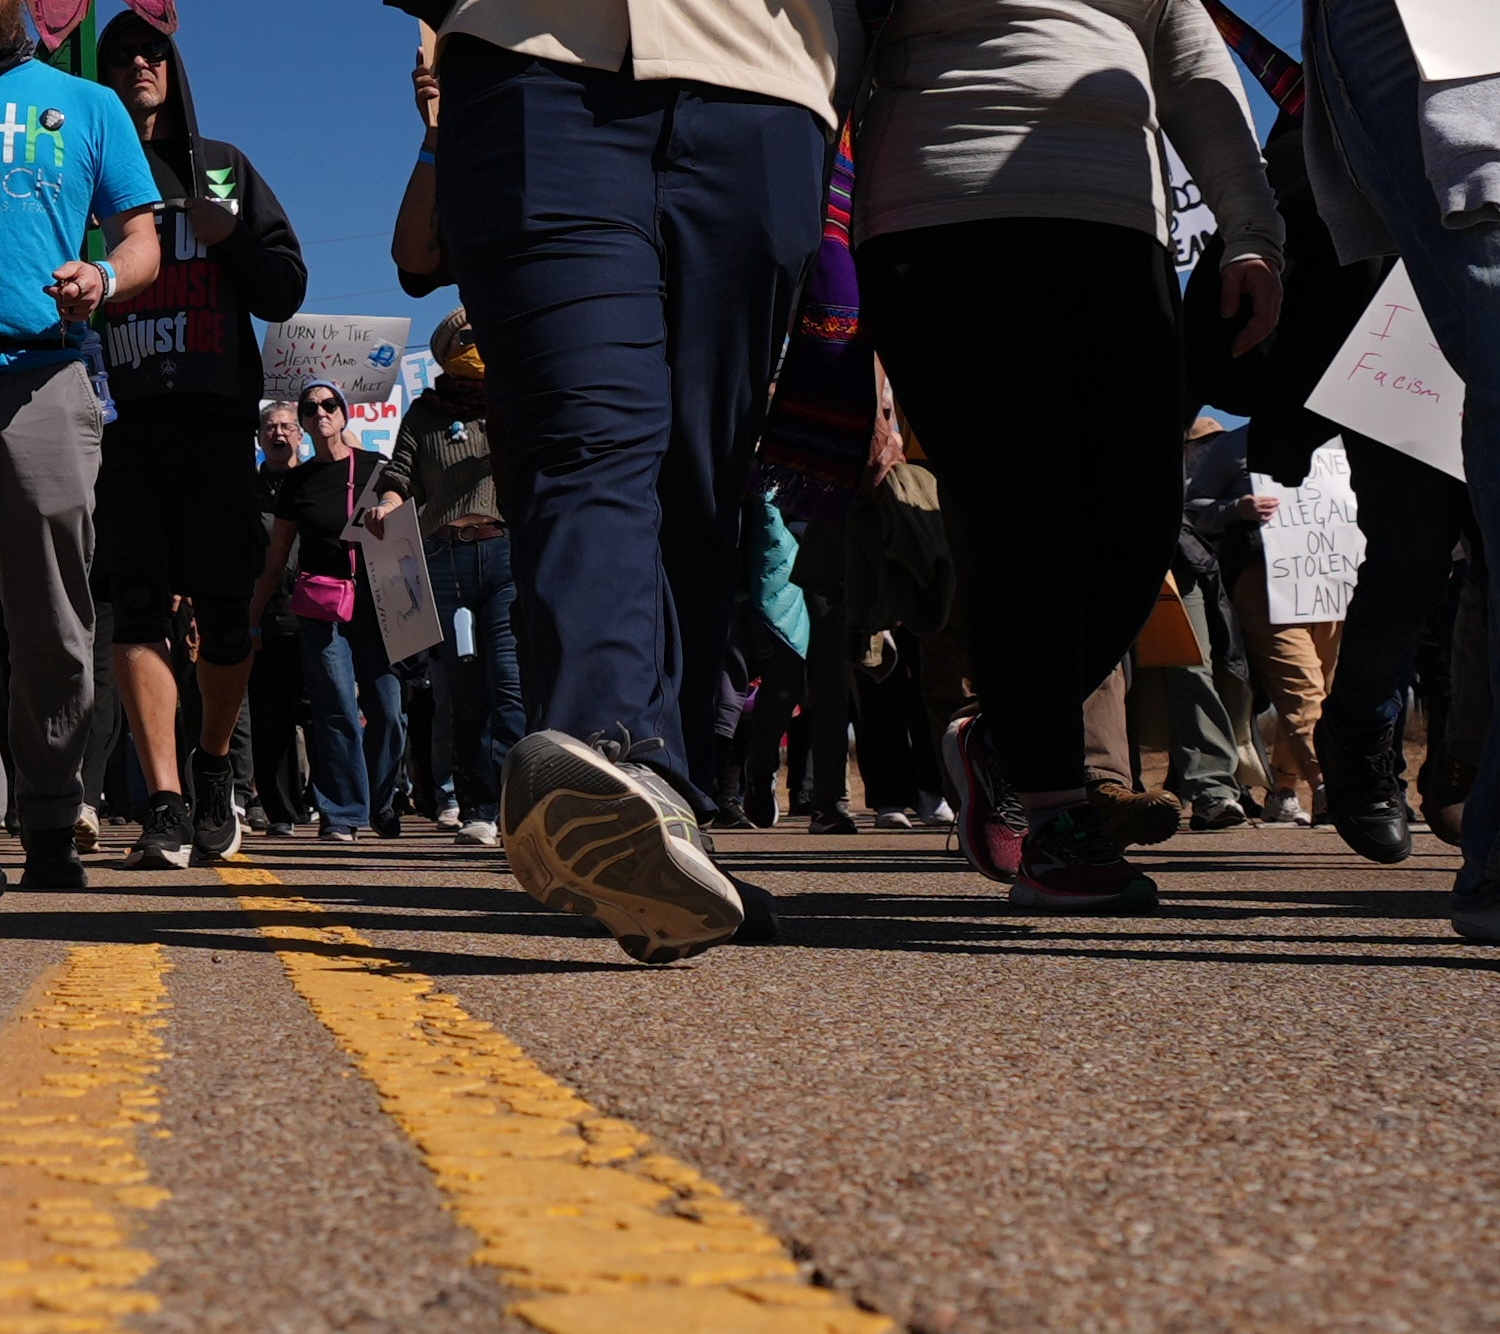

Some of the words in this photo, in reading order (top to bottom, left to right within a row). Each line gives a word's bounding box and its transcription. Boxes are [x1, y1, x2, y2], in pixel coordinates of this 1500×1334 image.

[277, 322, 316, 340] TURN
[344, 323, 374, 341] THE
[283, 349, 322, 367] HEAT
[1347, 352, 1441, 404] Facism
[1295, 484, 1322, 504] IS
[1265, 498, 1358, 529] ILLEGAL
[1306, 531, 1336, 555] ON
[1272, 553, 1361, 579] STOLEN
